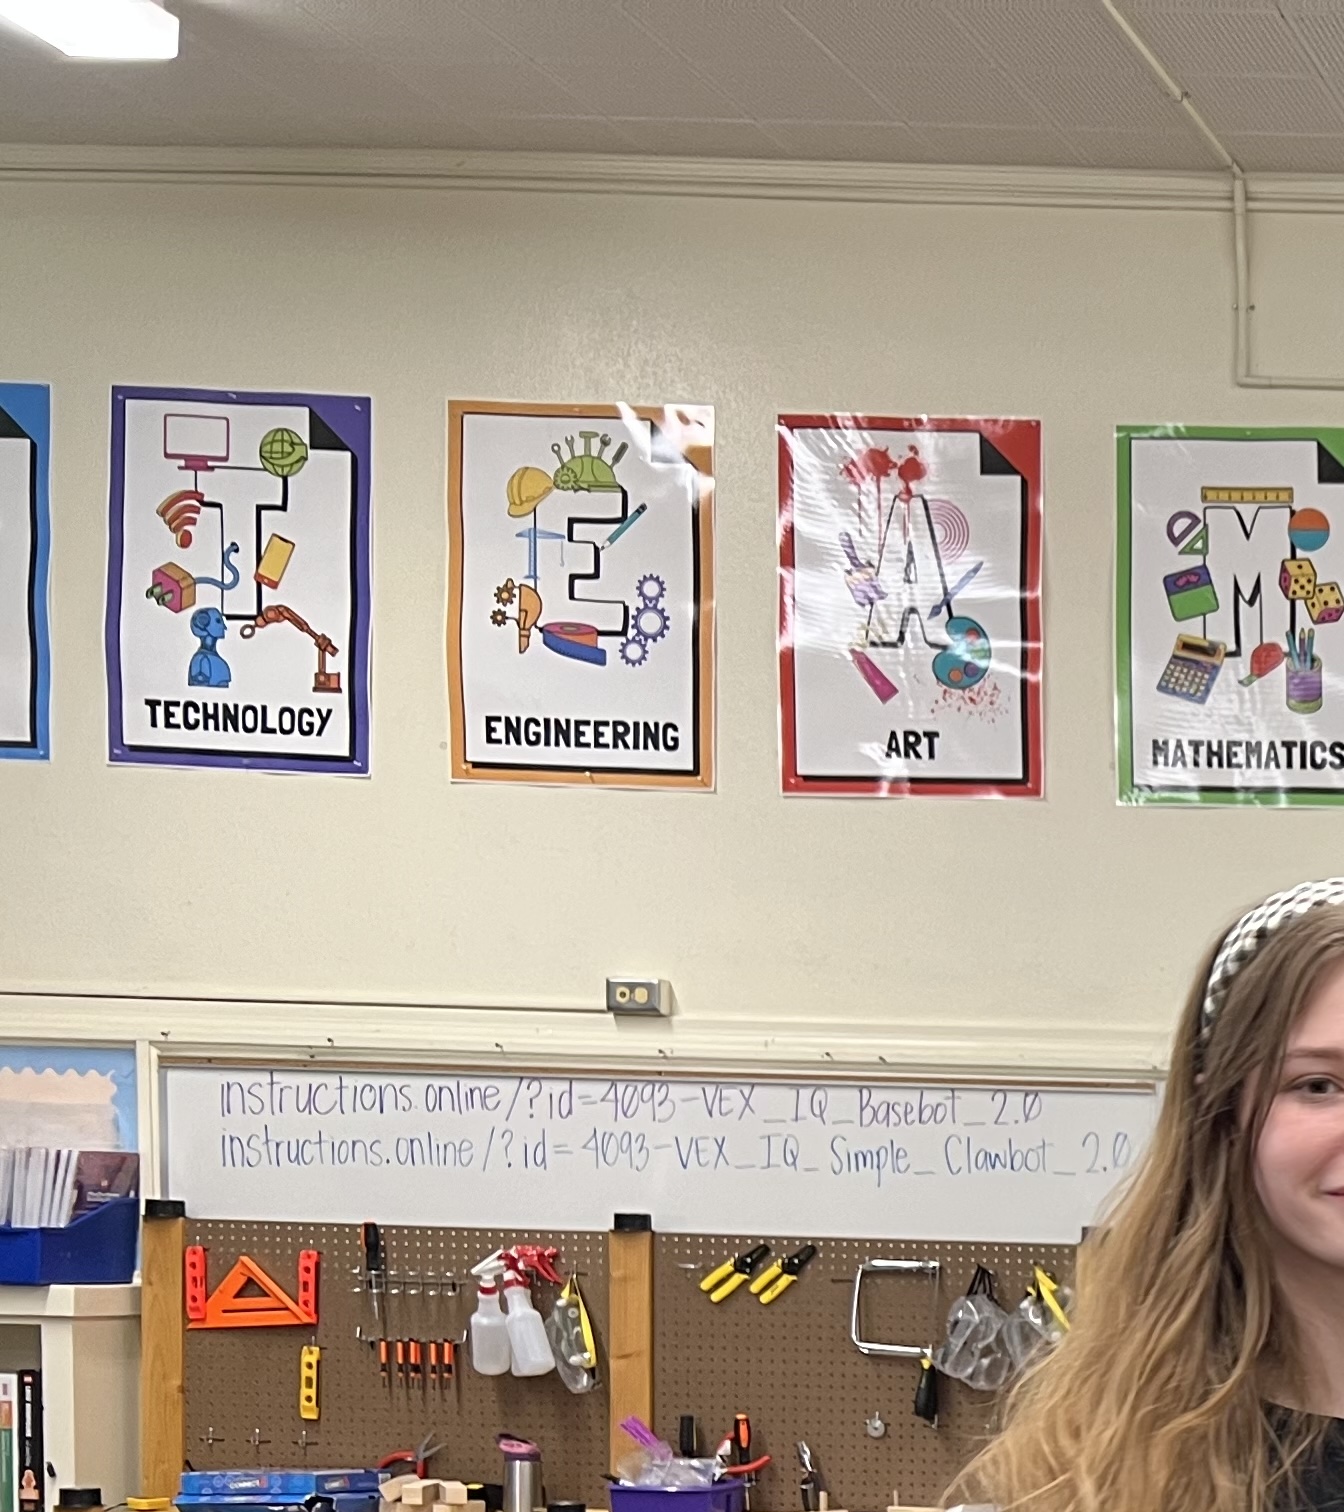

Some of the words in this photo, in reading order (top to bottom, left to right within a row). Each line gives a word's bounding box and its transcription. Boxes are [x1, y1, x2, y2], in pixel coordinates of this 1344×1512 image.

[144, 698, 333, 738] TECHNOLOGY
[484, 715, 680, 753] ENGINEERING
[884, 729, 940, 761] ART
